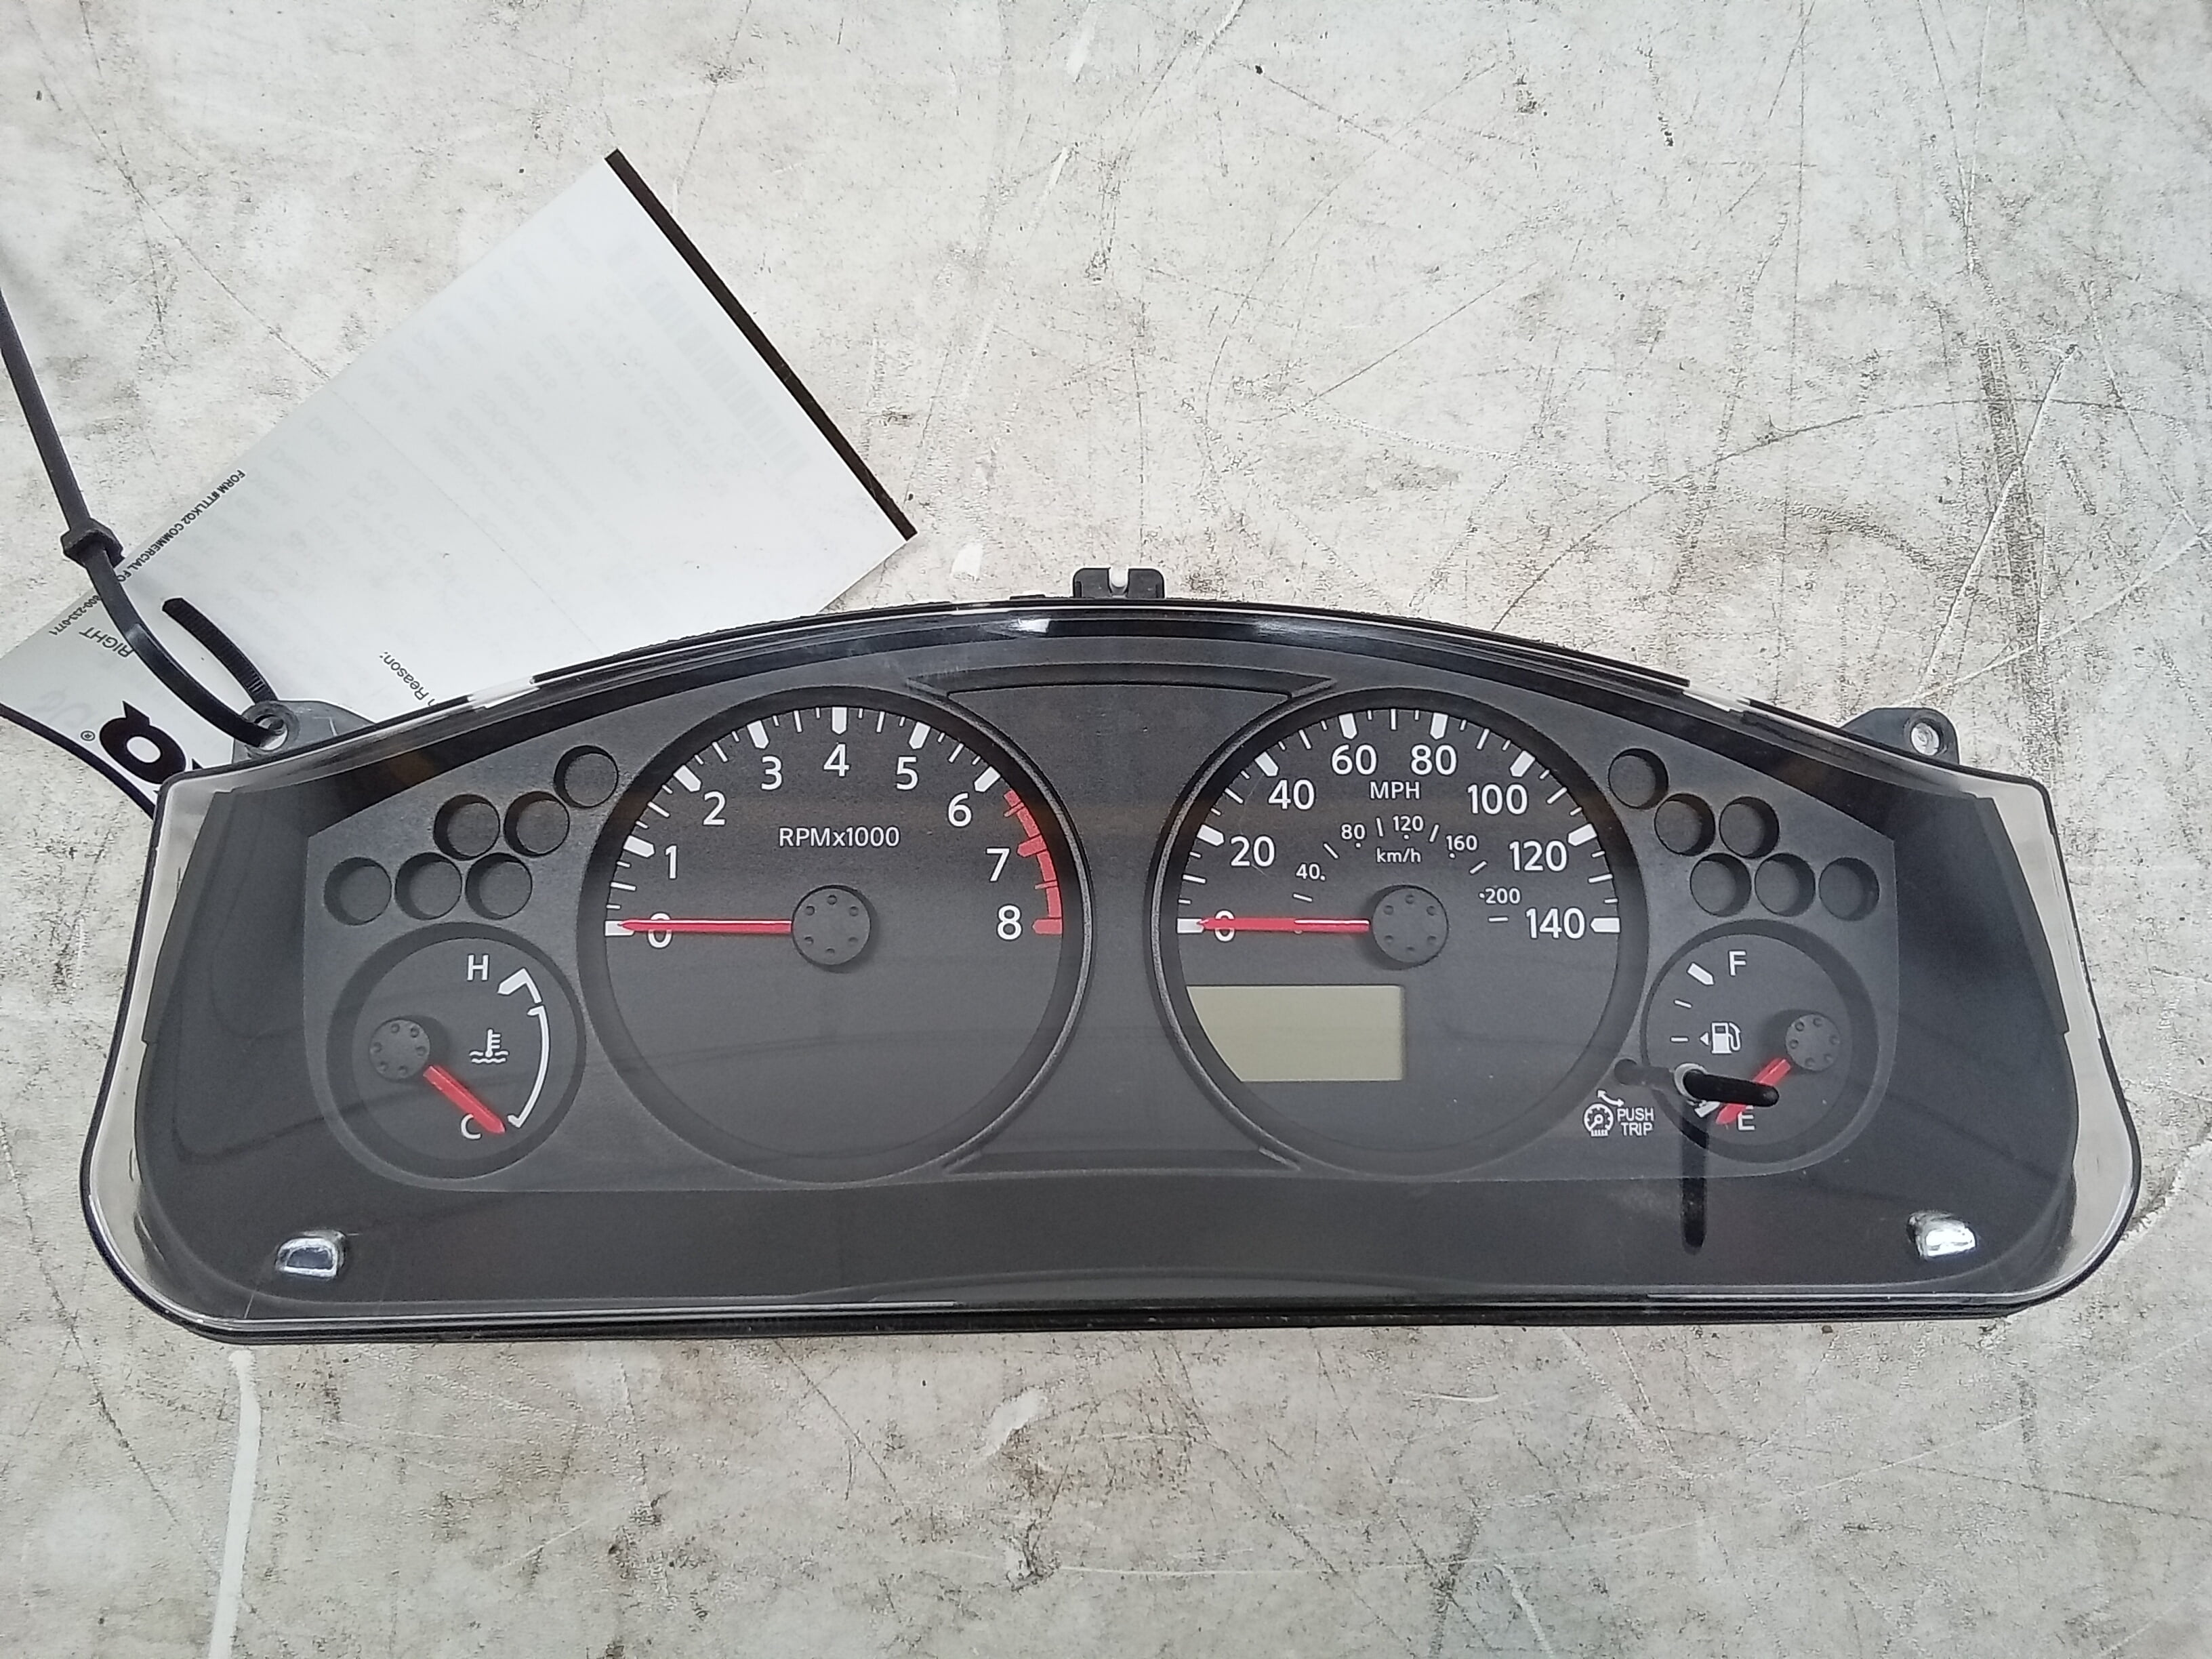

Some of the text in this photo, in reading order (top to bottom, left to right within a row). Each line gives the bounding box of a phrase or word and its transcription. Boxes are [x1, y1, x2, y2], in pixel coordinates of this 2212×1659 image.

[216, 469, 245, 494] FORM
[181, 491, 220, 525] #TTLKQ2
[127, 523, 184, 570] COMMERCIAL
[117, 570, 132, 582] FO
[79, 627, 134, 657] RIGHT
[379, 651, 429, 700] Reason:
[761, 756, 783, 791] 3
[823, 742, 849, 778] 4
[896, 756, 918, 791] 5
[1331, 744, 1378, 775] 60
[1410, 744, 1458, 775] 80
[1268, 779, 1314, 810] 40
[1370, 781, 1421, 800] MPH
[1467, 783, 1528, 815] 100
[703, 792, 726, 826] 2
[947, 792, 972, 827] 6
[1392, 815, 1424, 832] 120
[779, 826, 900, 848] RPMx1000
[1340, 824, 1366, 840] 80
[1446, 835, 1478, 852] 160
[664, 845, 678, 879] 1
[985, 847, 1010, 882] 7
[1230, 836, 1275, 867] 20
[1376, 848, 1422, 863] km/h
[1509, 840, 1567, 872] 120
[1295, 863, 1320, 880] 40
[1485, 888, 1520, 904] 200
[647, 913, 672, 948] 0
[996, 904, 1023, 941] 8
[1214, 910, 1235, 942] 0
[1525, 908, 1584, 939] 140
[466, 954, 489, 981] H
[1728, 950, 1746, 976] F
[460, 1114, 482, 1140] C
[1616, 1107, 1654, 1122] PUSH
[1620, 1122, 1654, 1136] TRIP
[1736, 1106, 1755, 1130] E
